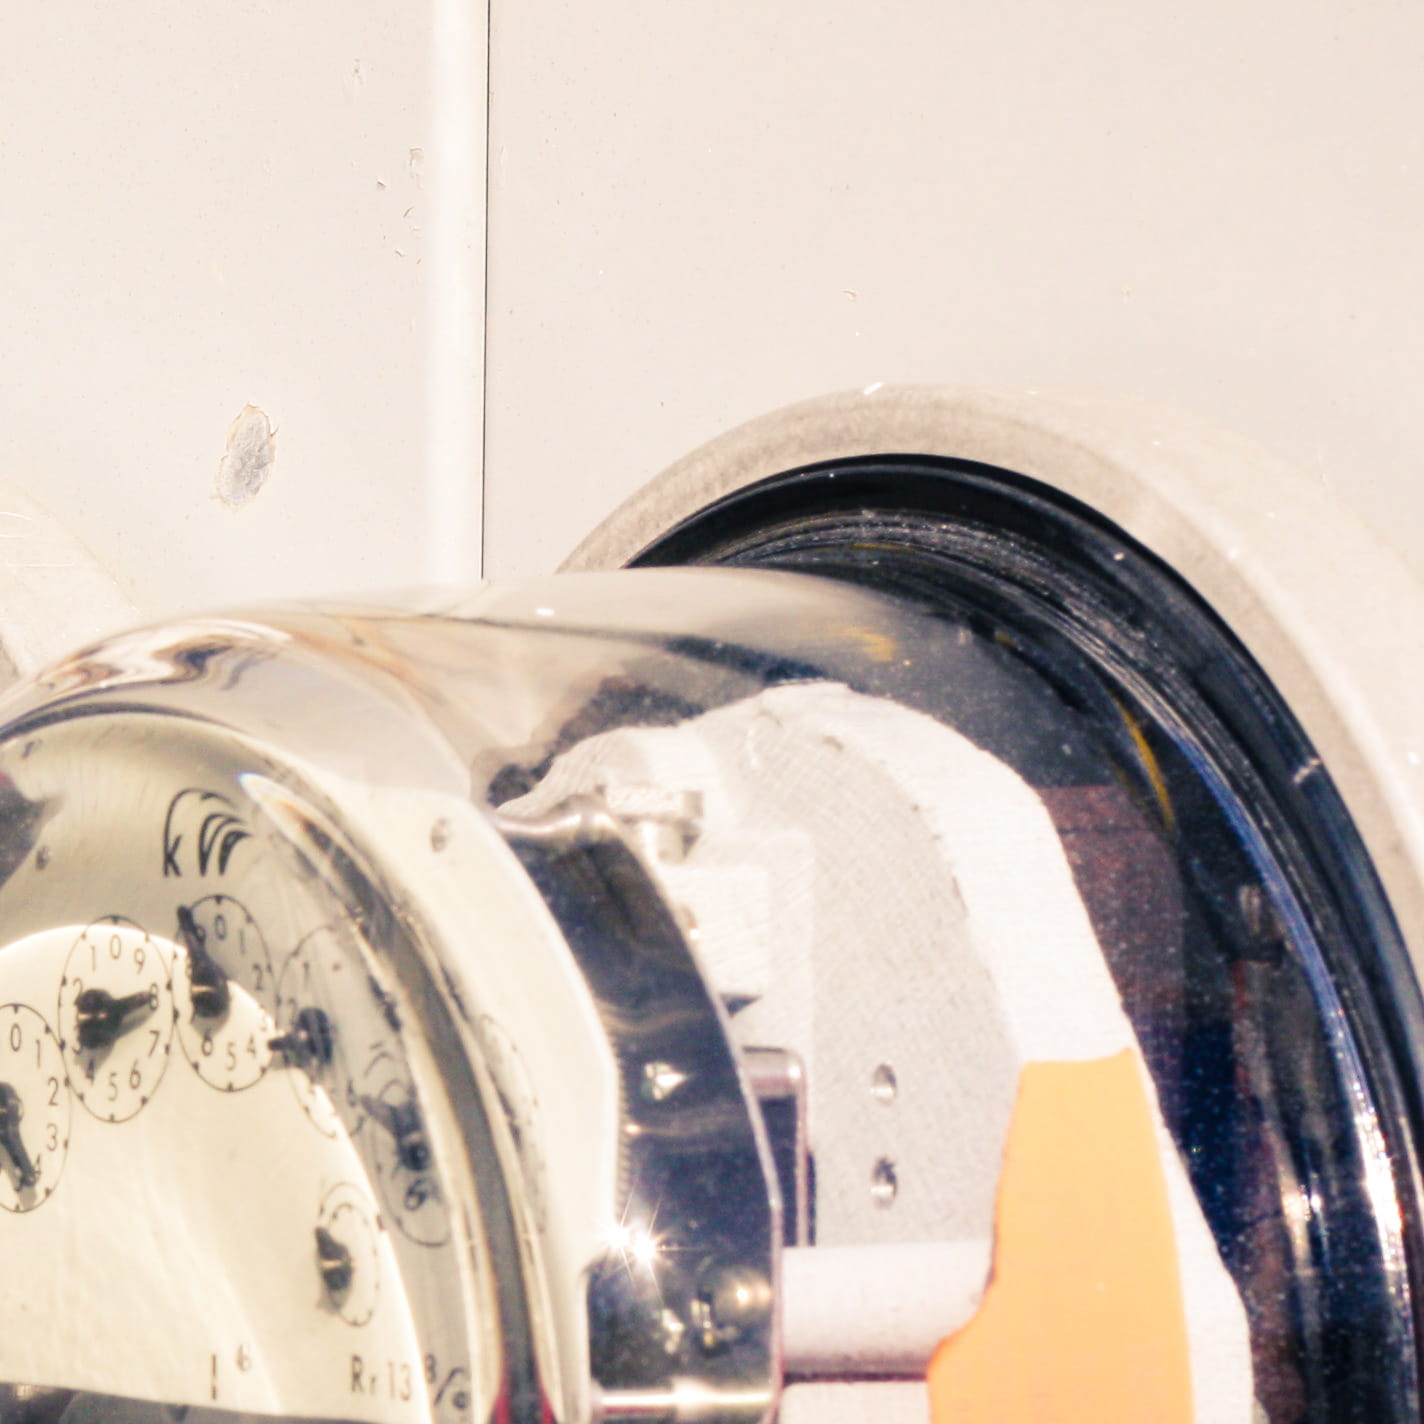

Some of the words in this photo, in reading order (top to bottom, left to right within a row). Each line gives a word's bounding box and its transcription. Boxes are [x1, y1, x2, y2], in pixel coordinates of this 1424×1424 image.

[214, 914, 229, 940] 0
[90, 944, 98, 973] 1
[110, 934, 122, 960] 0
[133, 947, 146, 976] 9
[252, 964, 265, 992] 2
[10, 1023, 22, 1052] 0
[148, 1030, 161, 1059] 7
[201, 1027, 214, 1057] 6
[35, 1039, 42, 1068] 1
[225, 1042, 237, 1072] 5
[107, 1072, 119, 1101] 5
[129, 1060, 142, 1090] 6
[47, 1077, 59, 1107] 2
[46, 1124, 58, 1152] 3
